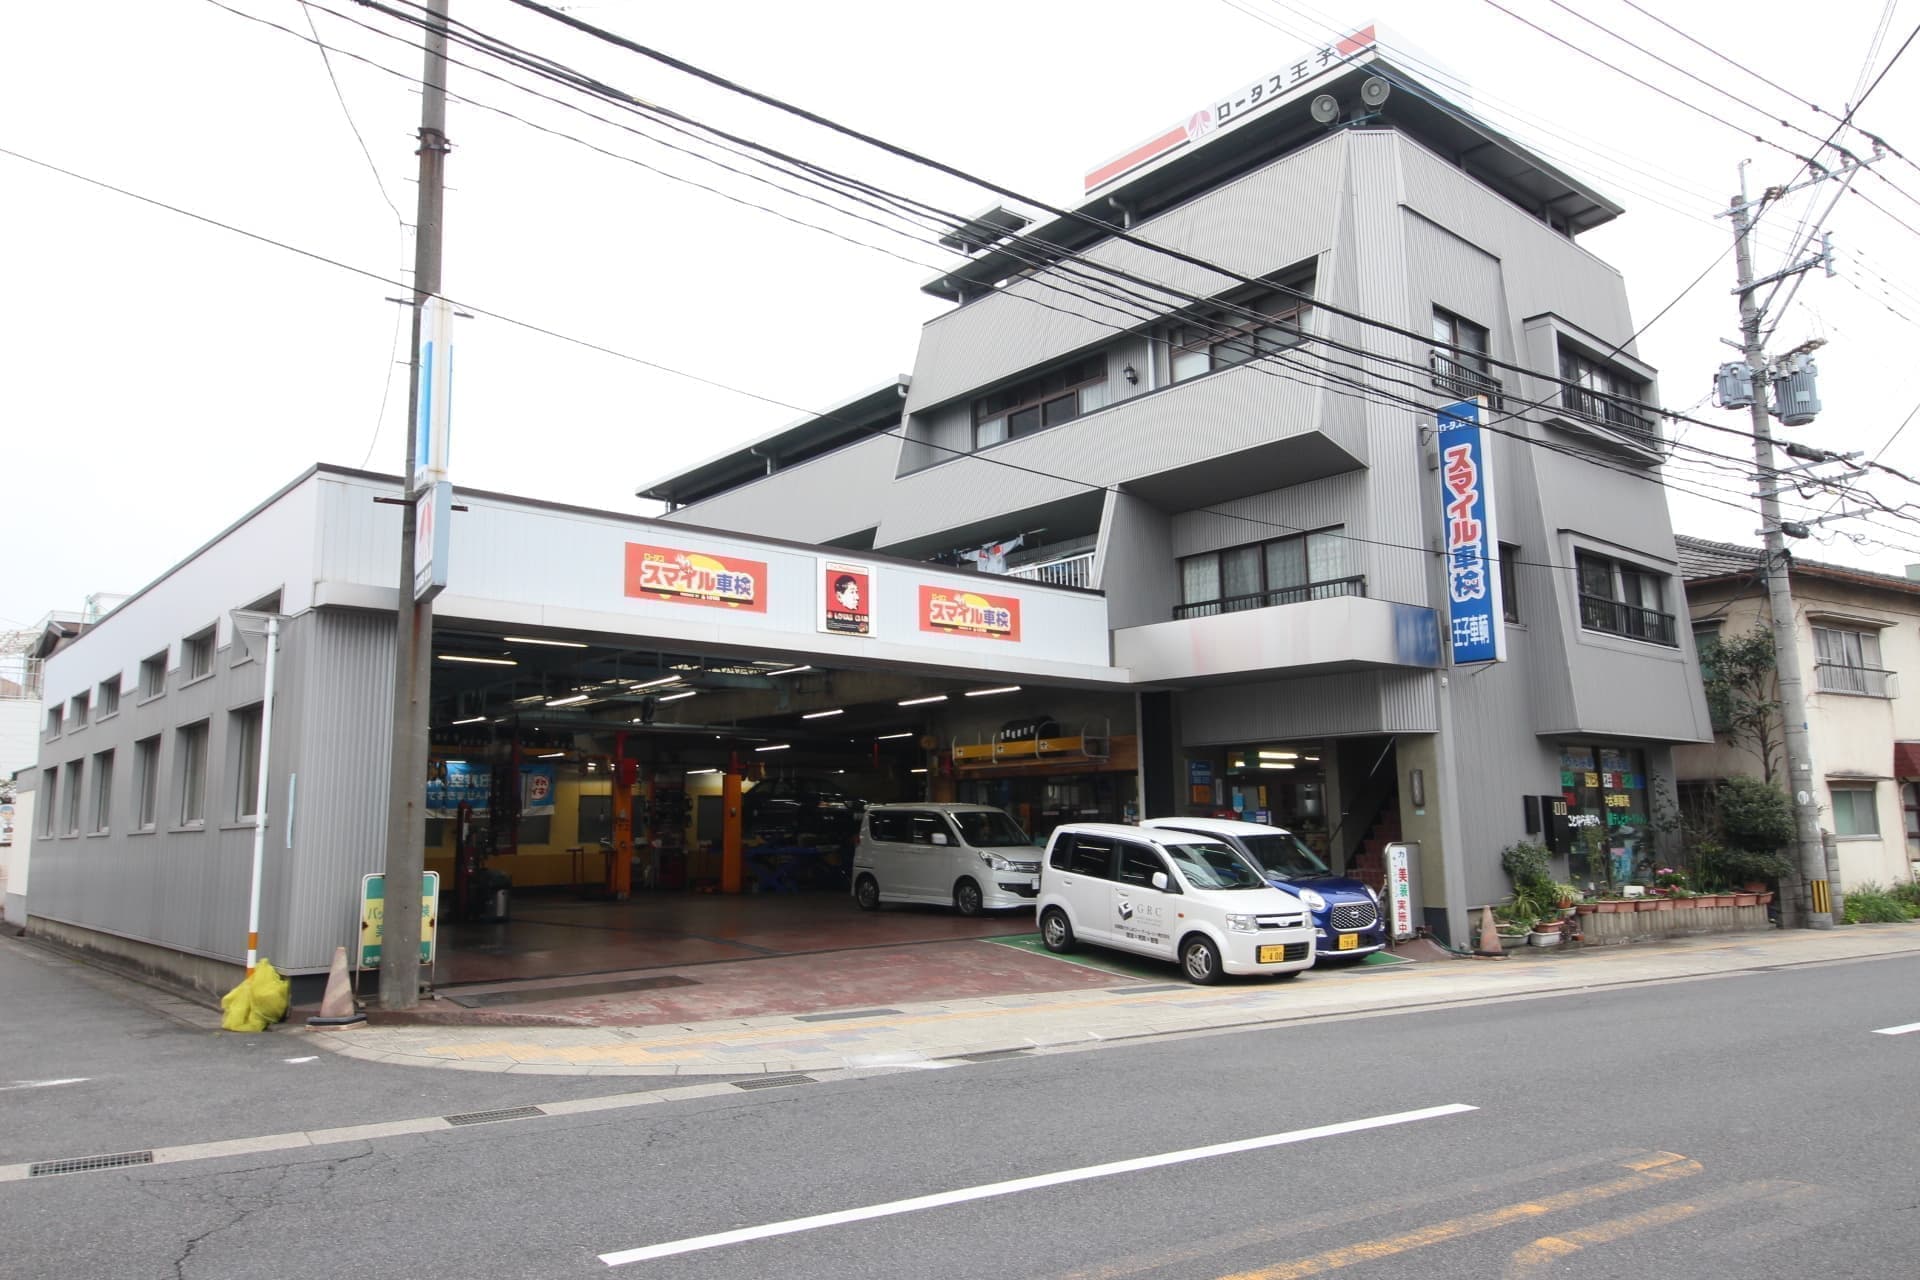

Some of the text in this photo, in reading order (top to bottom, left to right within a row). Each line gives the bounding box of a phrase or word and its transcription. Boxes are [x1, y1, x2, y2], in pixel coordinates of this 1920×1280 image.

[1217, 47, 1335, 121] ロータス王子
[1448, 447, 1481, 597] スマイル車検
[643, 564, 752, 596] スマイル車検
[932, 602, 1009, 628] スマイル車検
